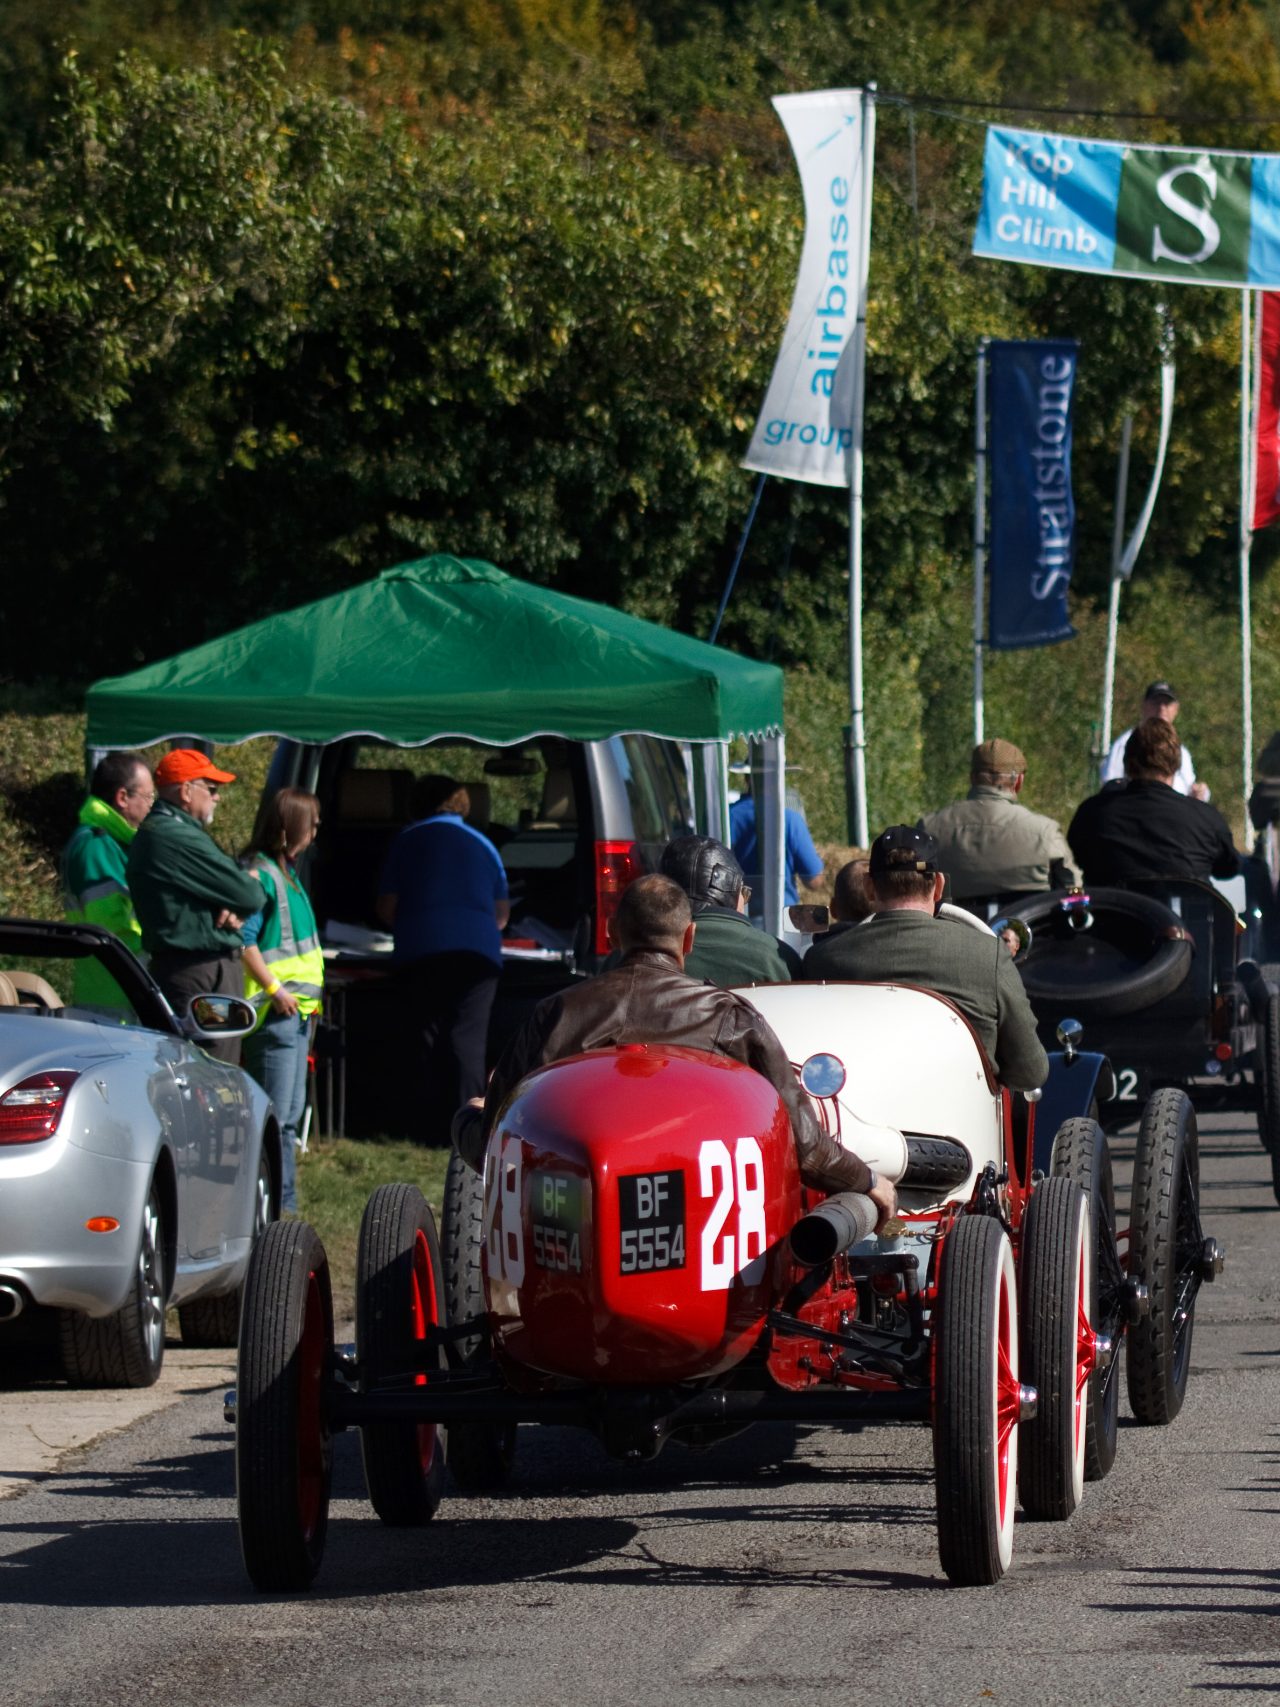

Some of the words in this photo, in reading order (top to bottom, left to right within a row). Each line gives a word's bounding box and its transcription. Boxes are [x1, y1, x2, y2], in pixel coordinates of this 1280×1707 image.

[1005, 143, 1074, 177] Kop
[1002, 178, 1057, 211] Hill
[995, 213, 1098, 255] Climb
[808, 174, 849, 399] airbase
[763, 417, 852, 454] group
[1030, 354, 1073, 600] Stratstone
[1108, 1069, 1138, 1102] 2
[542, 1175, 568, 1219] BF
[636, 1174, 669, 1220] BF
[699, 1136, 767, 1292] 28
[533, 1228, 582, 1274] 5554
[620, 1224, 686, 1272] 5554
